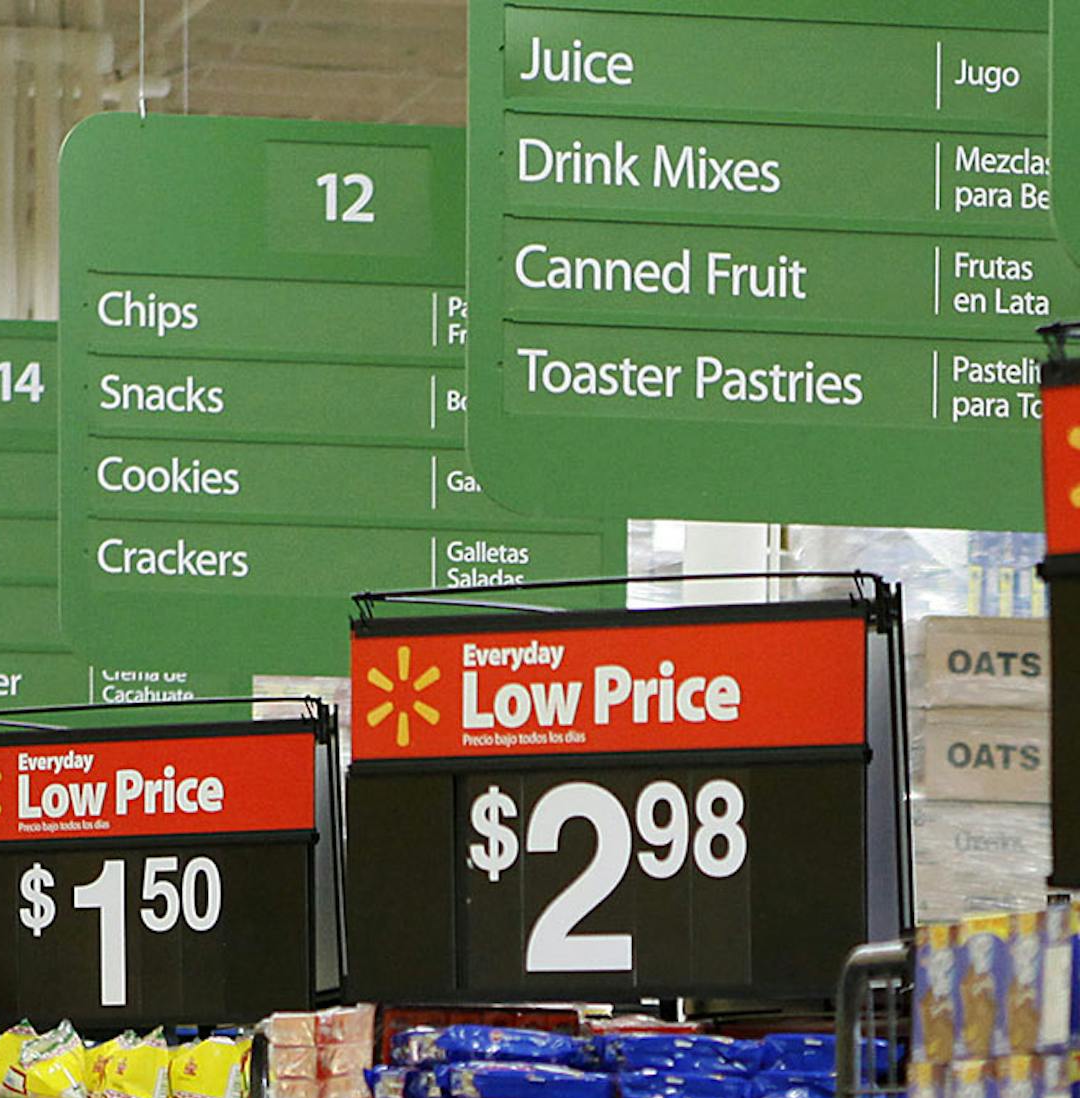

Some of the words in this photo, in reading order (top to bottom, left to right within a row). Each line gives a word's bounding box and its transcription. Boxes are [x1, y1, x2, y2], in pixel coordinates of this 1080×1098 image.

[520, 36, 634, 85] Juice
[954, 58, 1020, 93] Jugo
[519, 138, 641, 187] Drink
[653, 144, 781, 193] Mixes
[316, 173, 375, 223] 12
[955, 186, 1013, 213] para
[515, 244, 690, 294] Canned
[707, 252, 807, 299] Fruit
[954, 251, 1034, 281] Frutas
[97, 290, 199, 337] Chips
[953, 292, 987, 314] en
[995, 287, 1050, 316] Lata
[100, 374, 224, 413] Snacks
[517, 348, 682, 398] Toaster
[696, 356, 863, 406] Pastries
[952, 396, 1010, 423] para
[97, 456, 240, 495] Cookies
[97, 538, 249, 577] Crackers
[446, 540, 529, 565] Galletas
[446, 567, 525, 589] Saladas
[462, 641, 565, 671] Everyday
[947, 648, 1042, 678] OATS
[462, 675, 583, 729] Low
[593, 660, 741, 725] Price
[18, 750, 94, 774] Everyday
[947, 742, 1041, 771] OATS
[18, 774, 107, 819] Low
[115, 765, 224, 815] Price
